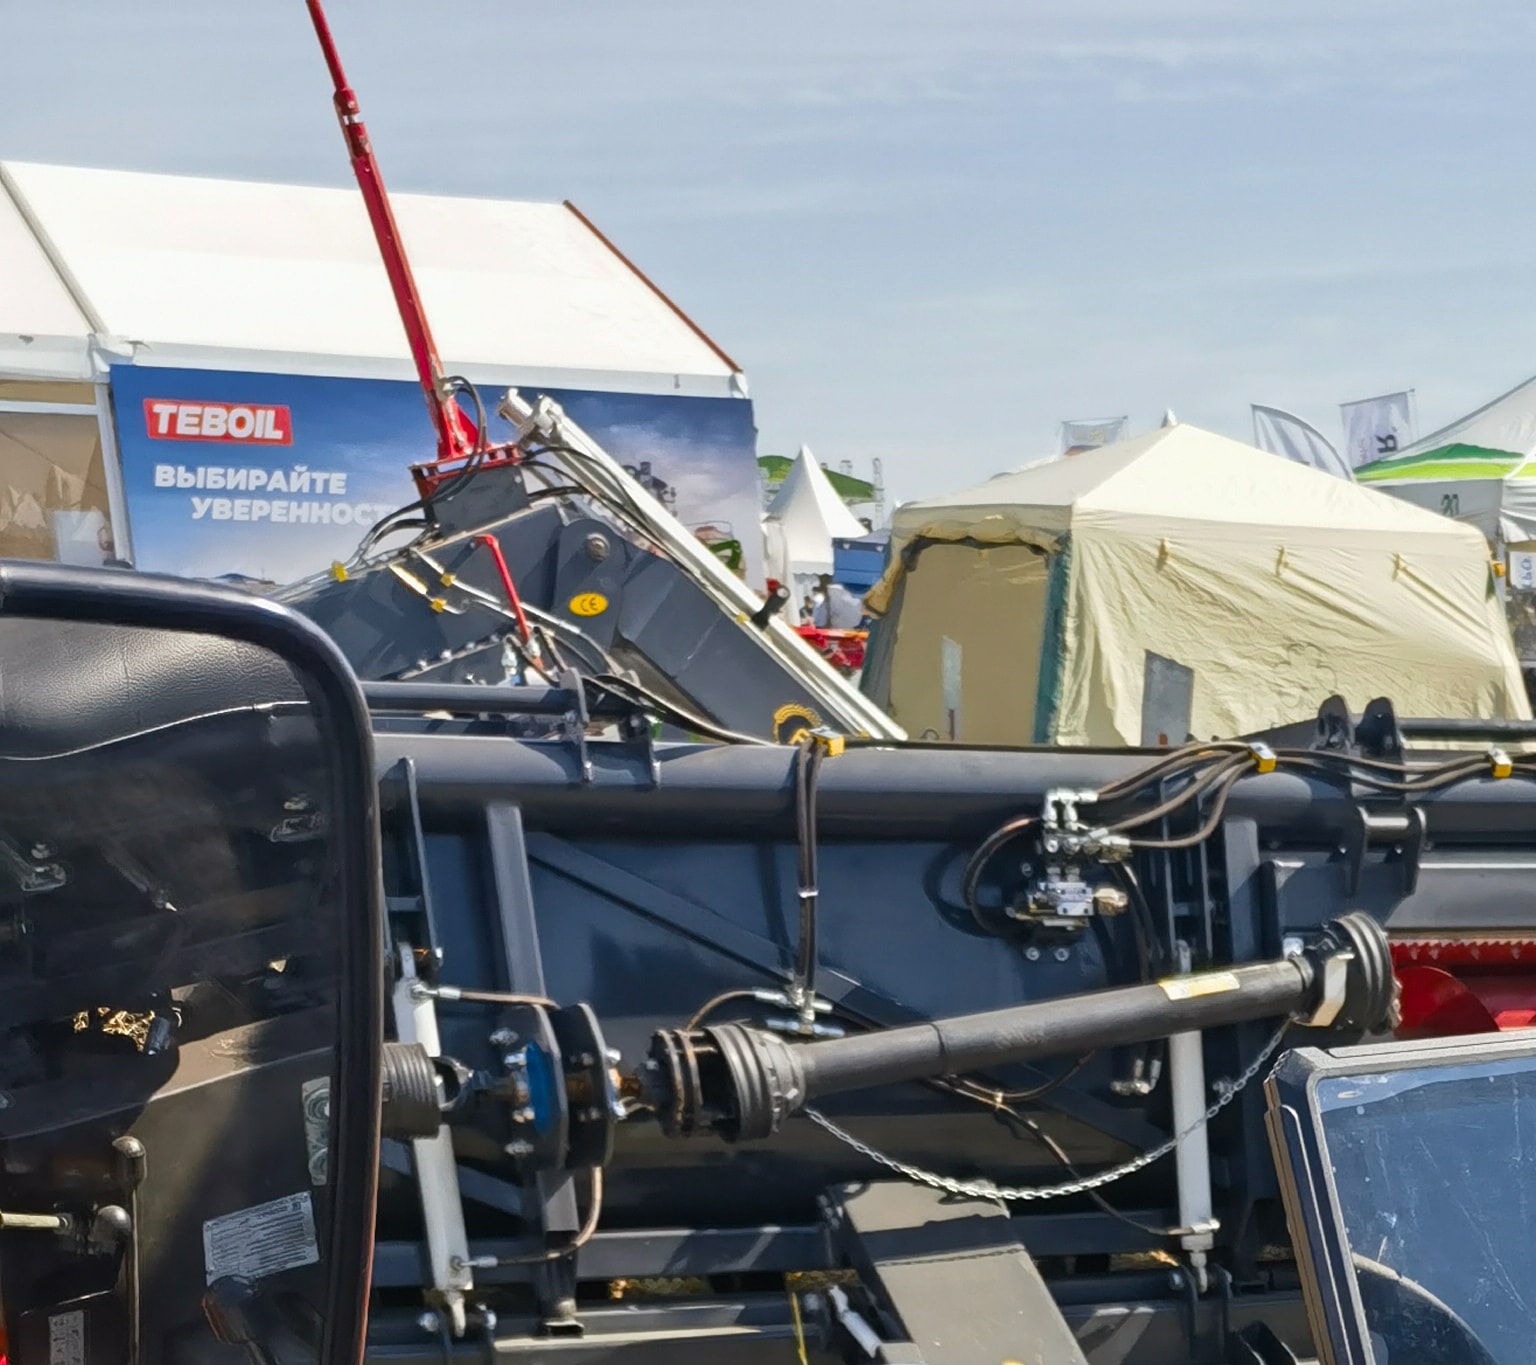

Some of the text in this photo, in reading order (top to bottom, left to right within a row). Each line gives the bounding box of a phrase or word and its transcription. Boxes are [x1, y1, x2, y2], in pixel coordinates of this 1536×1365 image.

[153, 404, 283, 440] TEBOIL
[154, 464, 347, 495] ВЫБИРАЙТЕ
[580, 597, 598, 612] CE
